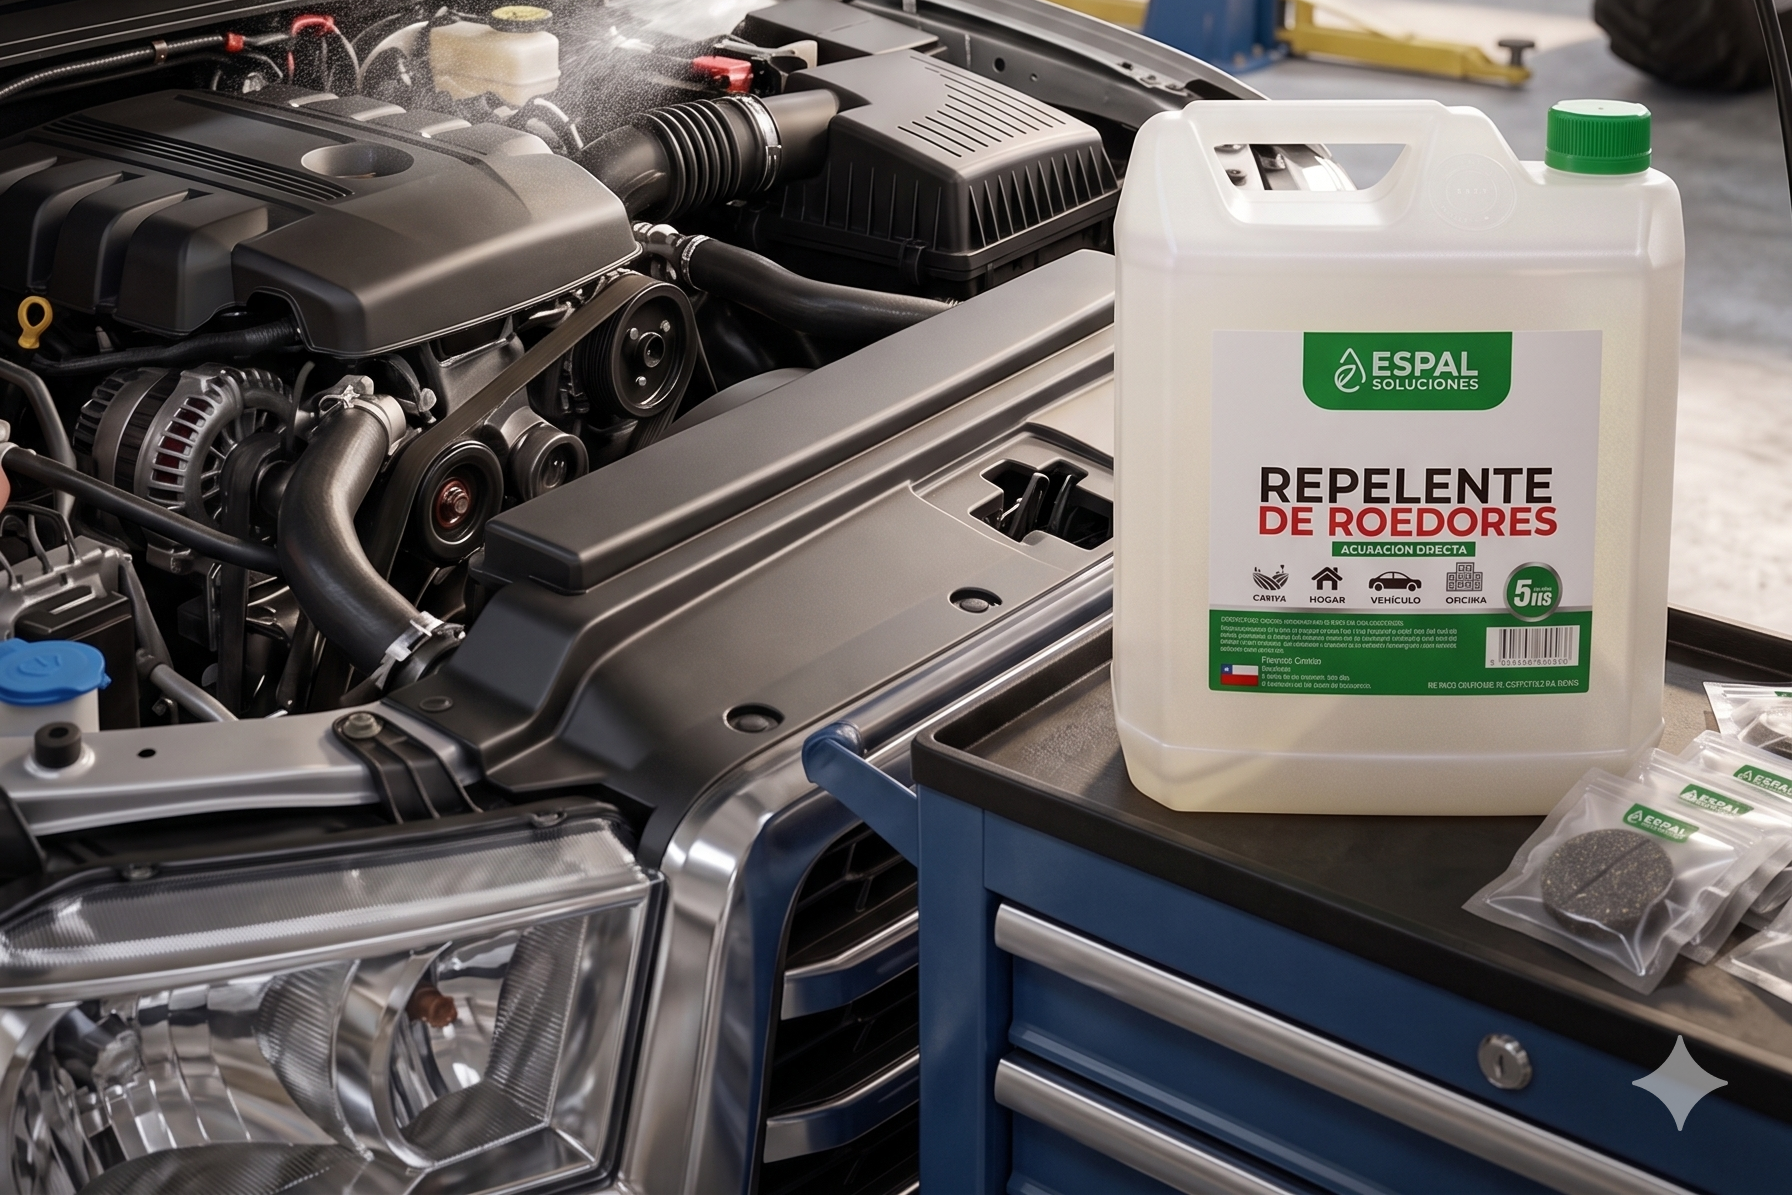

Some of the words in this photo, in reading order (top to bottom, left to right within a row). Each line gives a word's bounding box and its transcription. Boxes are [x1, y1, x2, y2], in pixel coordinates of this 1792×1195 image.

[1372, 351, 1479, 376] ESPAL
[1372, 378, 1479, 391] SOLUCIONES
[1260, 466, 1553, 504] REPELENTE
[1258, 506, 1314, 537] DE
[1328, 506, 1558, 537] ROEDORES
[1309, 596, 1346, 604] HOGAR
[1370, 595, 1421, 604] VEHÍCULO
